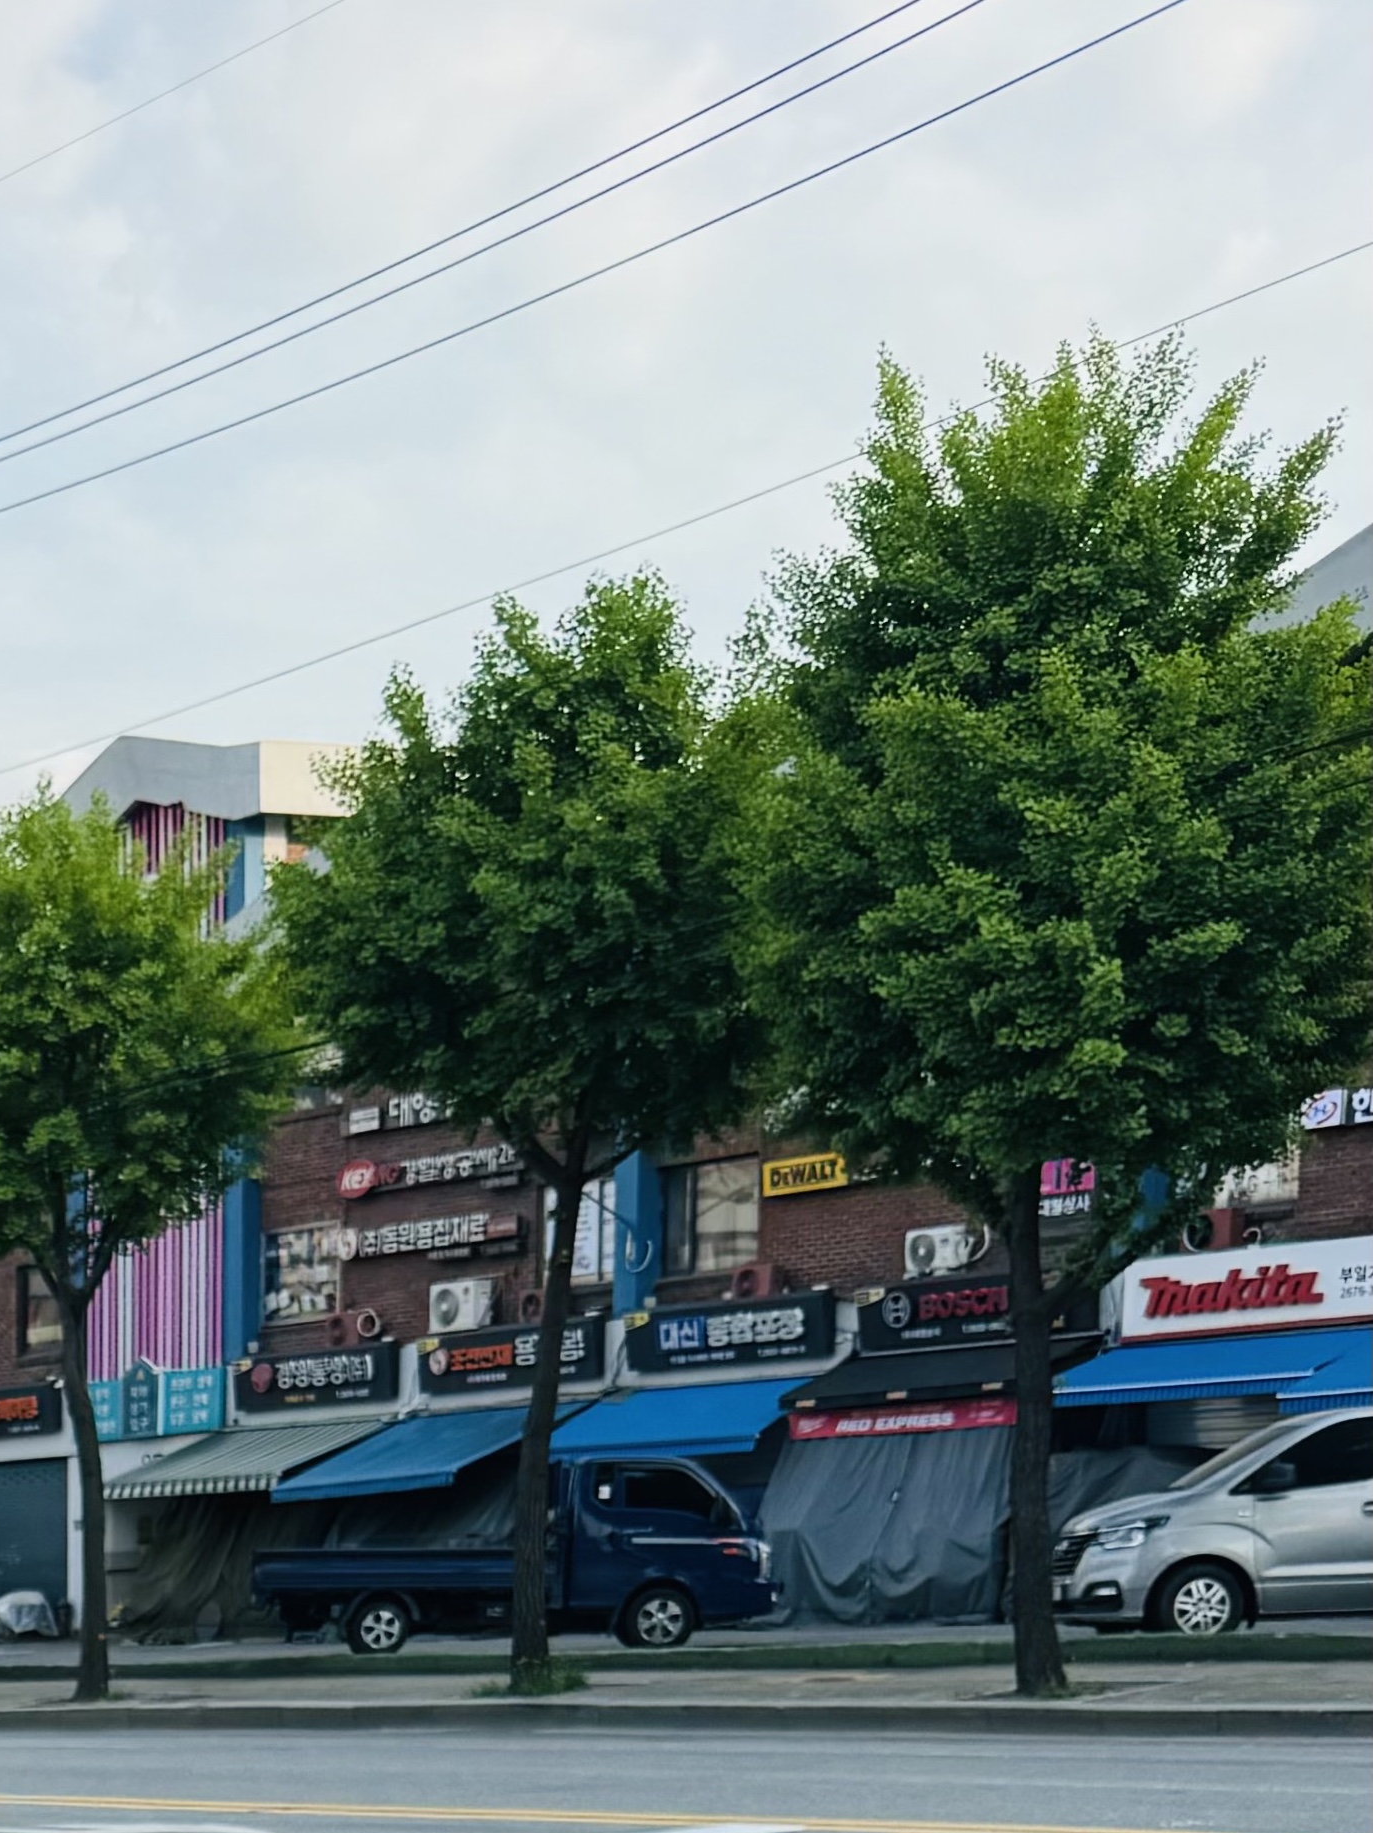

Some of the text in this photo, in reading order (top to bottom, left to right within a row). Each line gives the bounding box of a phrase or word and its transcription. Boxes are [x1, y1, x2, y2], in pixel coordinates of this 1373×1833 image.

[918, 1286, 1009, 1320] BOSCH
[659, 1319, 699, 1350] 대신
[835, 1417, 873, 1433] RED
[874, 1411, 954, 1432] EXPRESS
